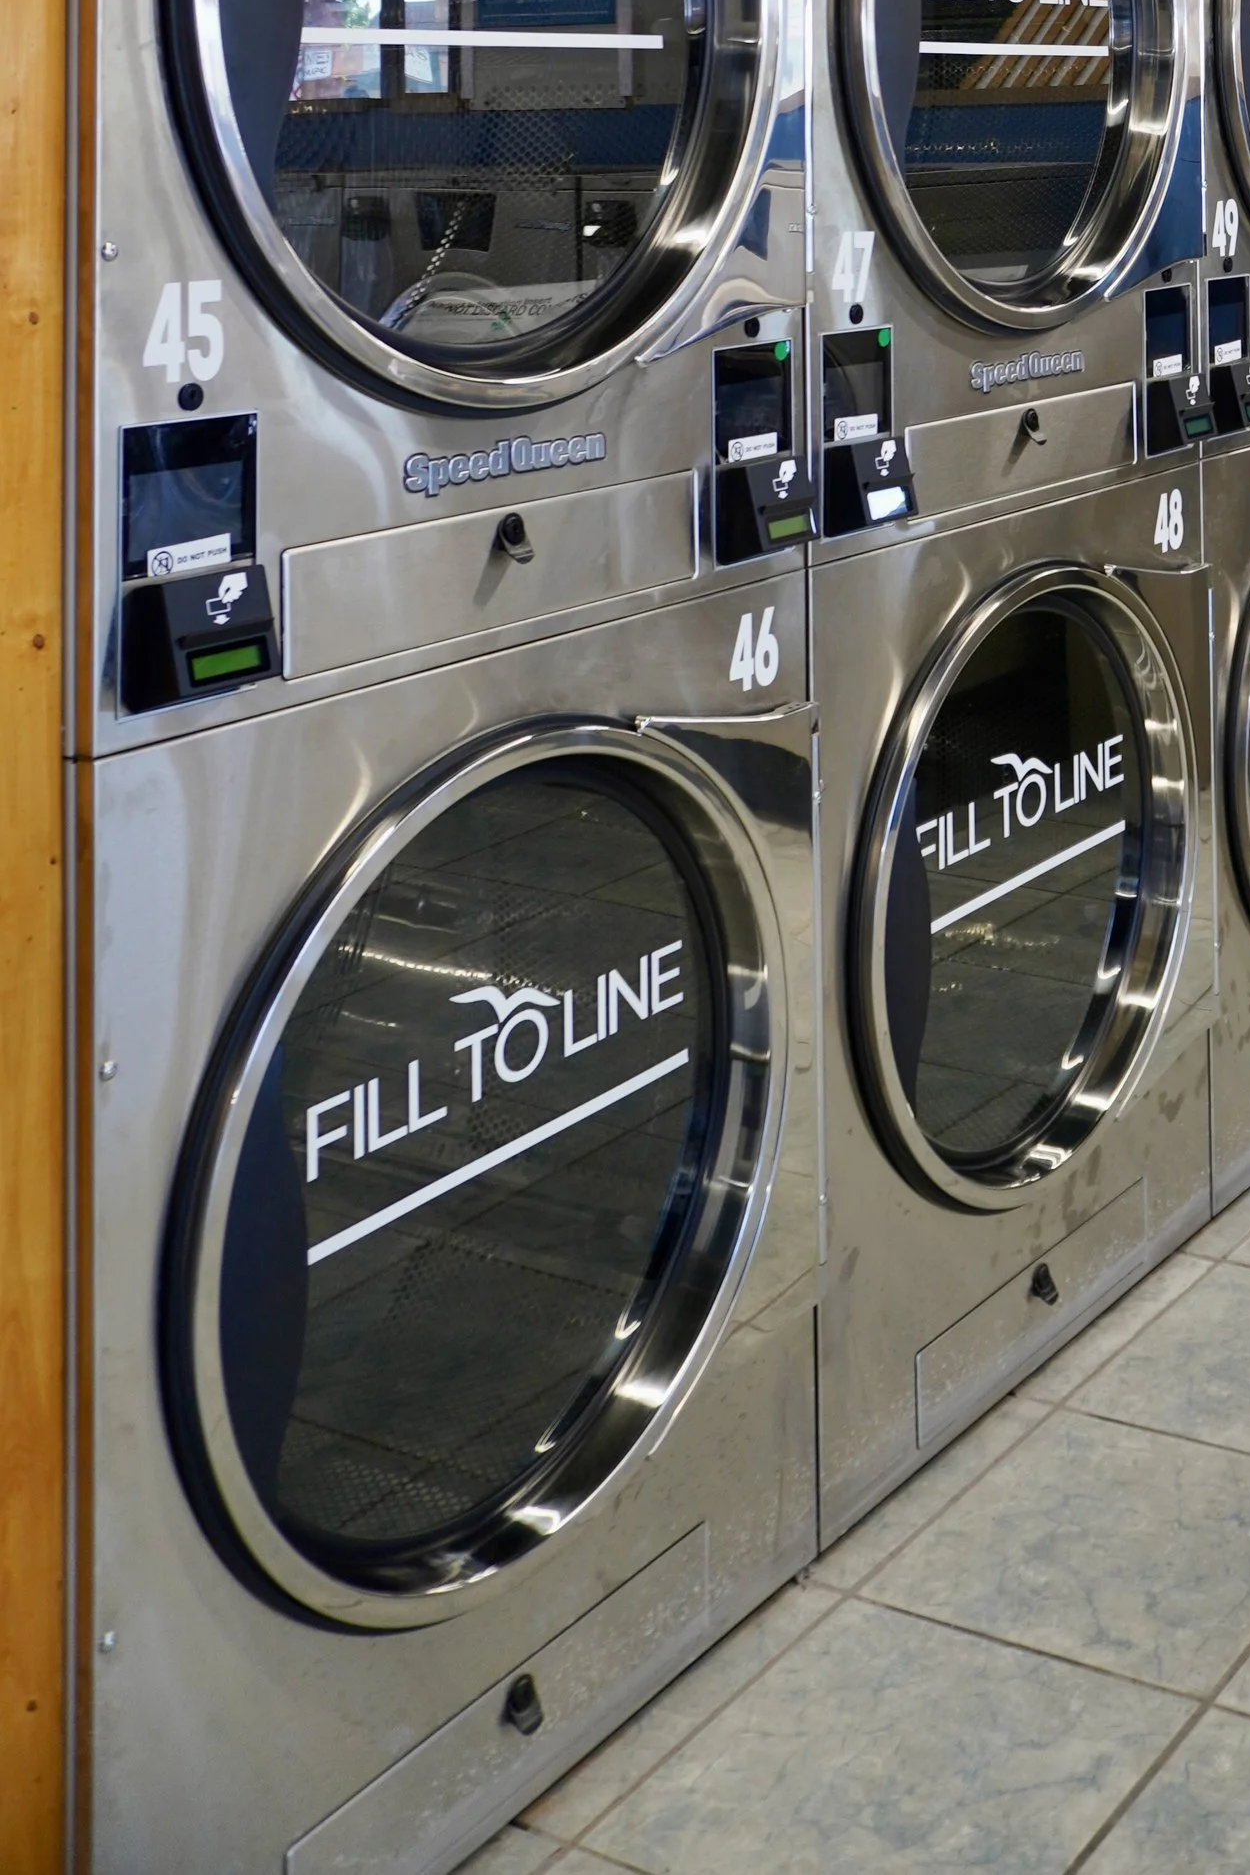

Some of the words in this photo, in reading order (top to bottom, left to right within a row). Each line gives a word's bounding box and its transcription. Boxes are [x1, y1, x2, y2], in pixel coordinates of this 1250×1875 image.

[831, 231, 875, 303] 47
[1212, 198, 1239, 256] 49
[143, 279, 224, 383] 45
[1154, 488, 1183, 553] 48
[729, 606, 779, 692] 46
[993, 773, 1047, 838] TO
[1054, 734, 1124, 813] LINE
[306, 1059, 448, 1183] FILL
[454, 1008, 549, 1102] TO
[564, 940, 683, 1057] LINE
